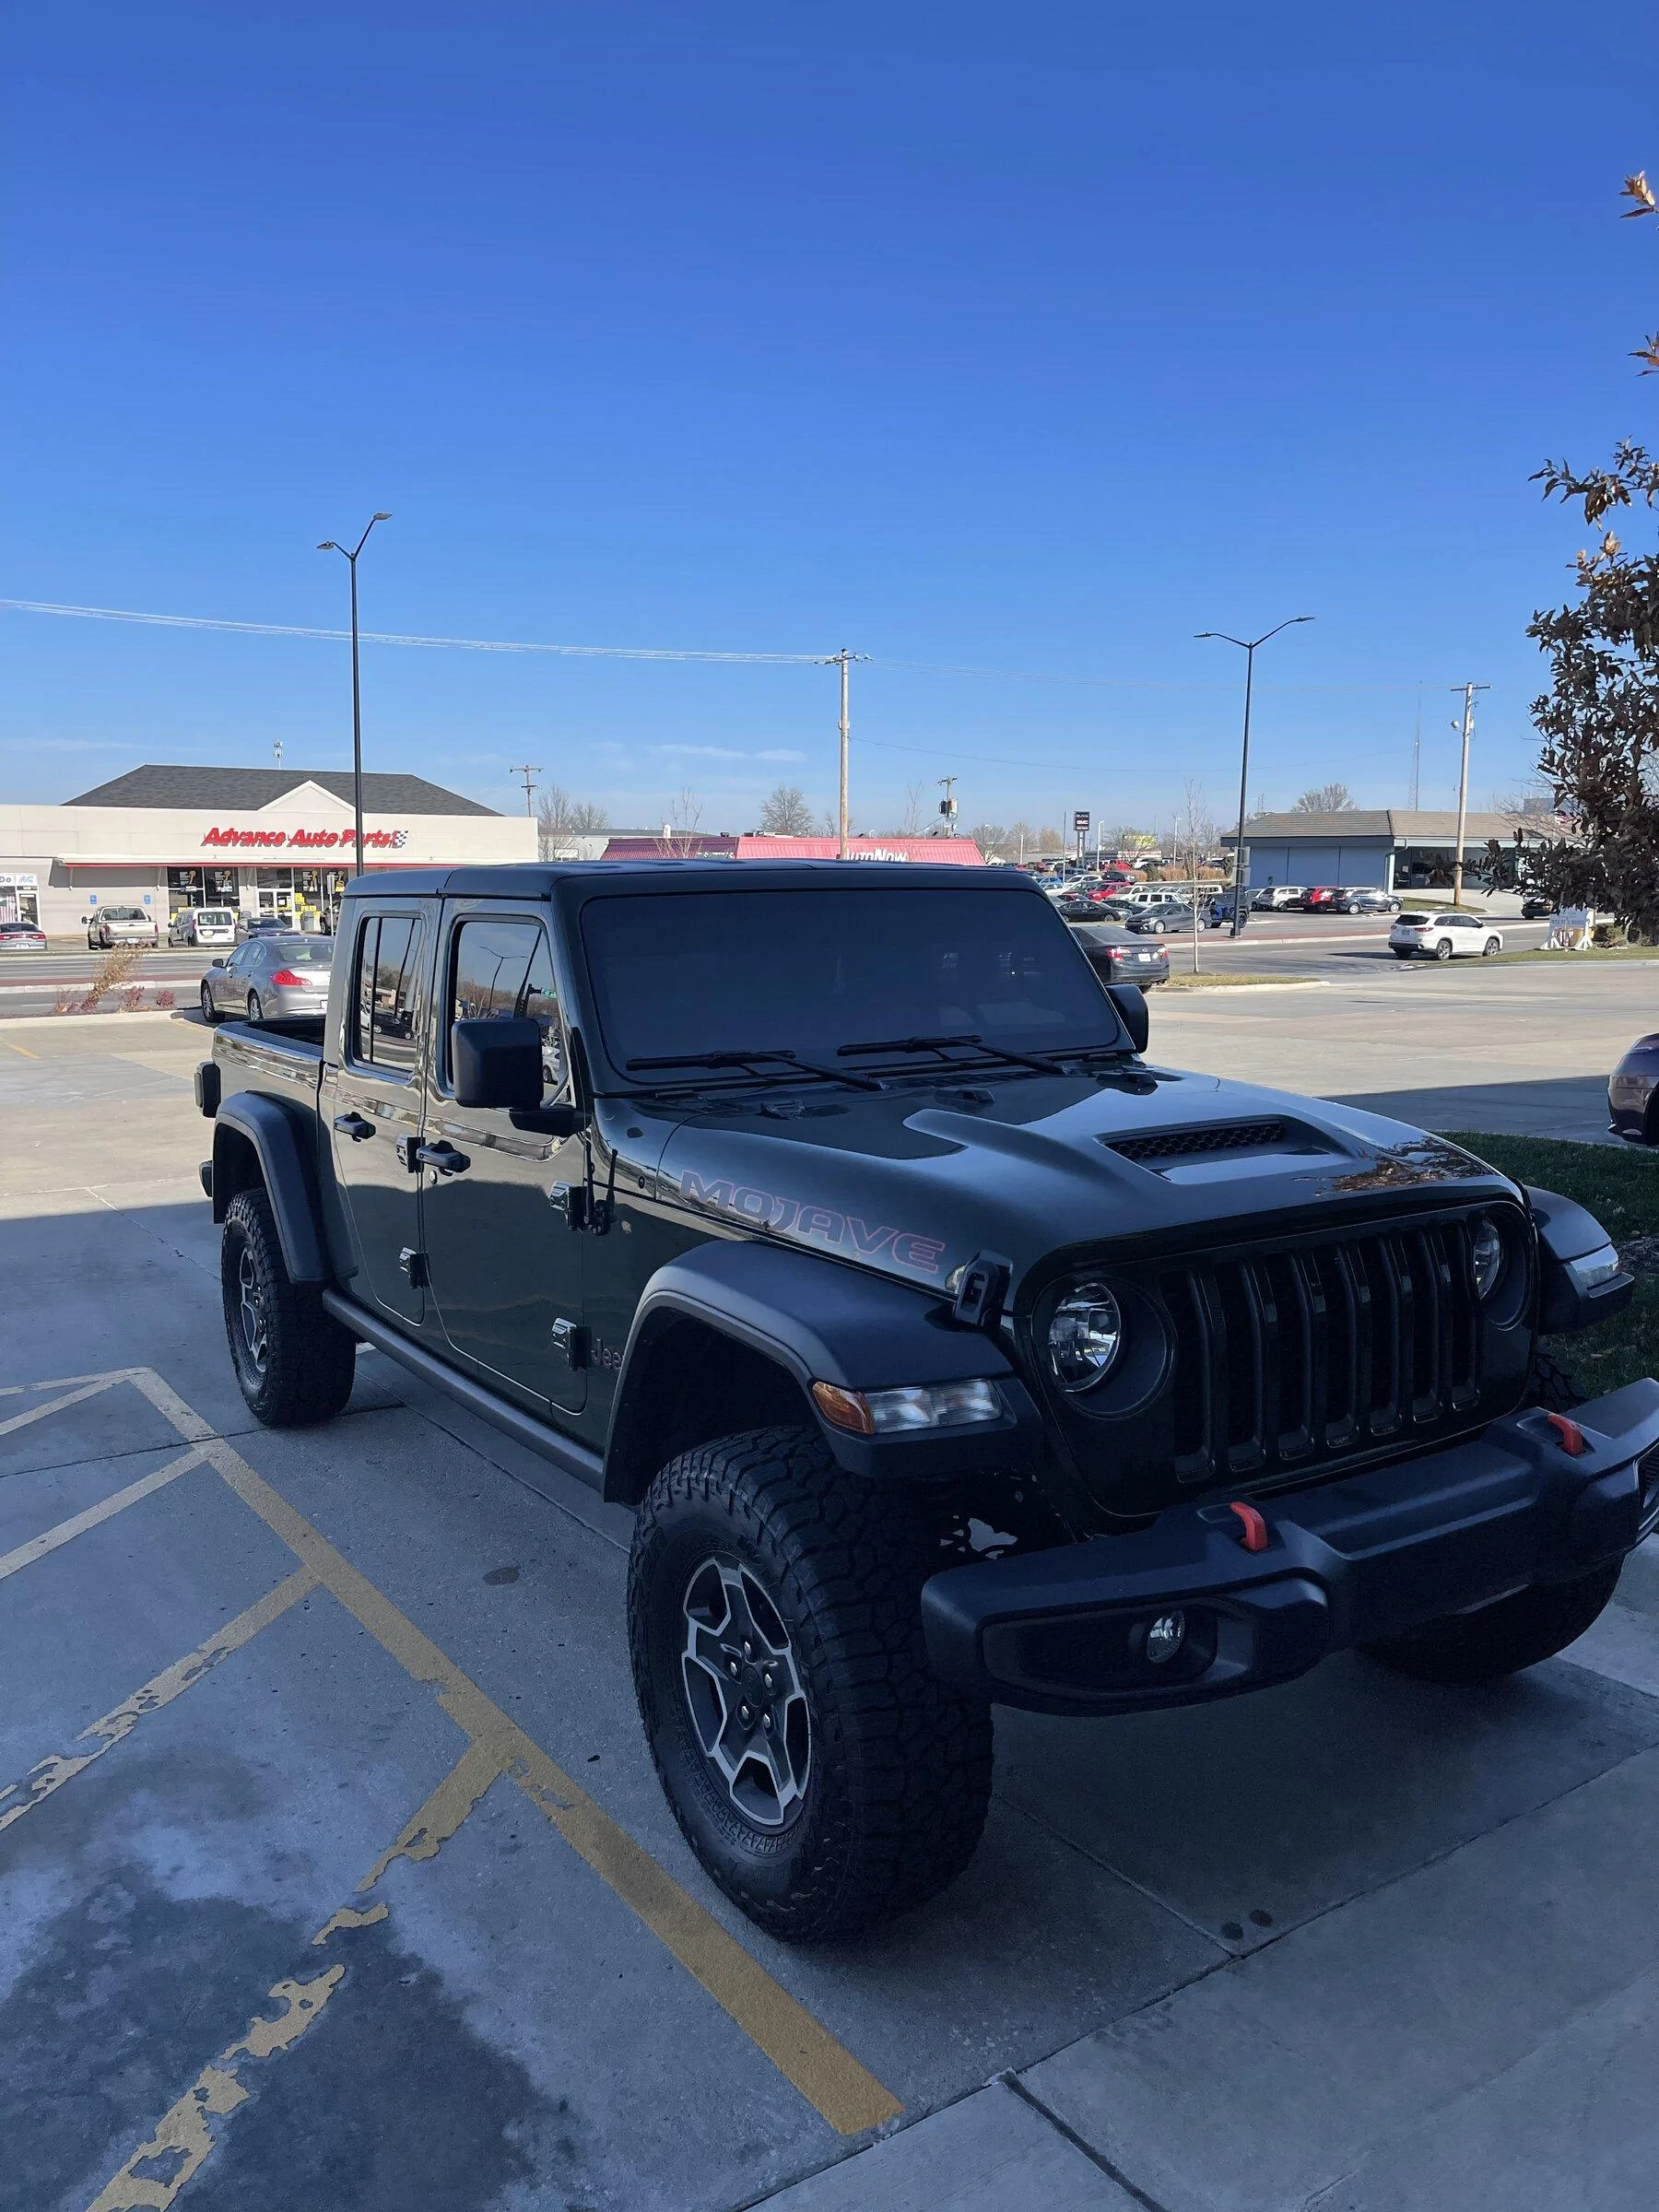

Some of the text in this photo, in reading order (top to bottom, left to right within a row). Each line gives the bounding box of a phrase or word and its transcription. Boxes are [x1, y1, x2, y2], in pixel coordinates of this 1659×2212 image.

[200, 828, 286, 847] Advance
[287, 829, 338, 848] Auto
[680, 1170, 946, 1274] MOJAVE
[591, 1338, 623, 1371] Jee
